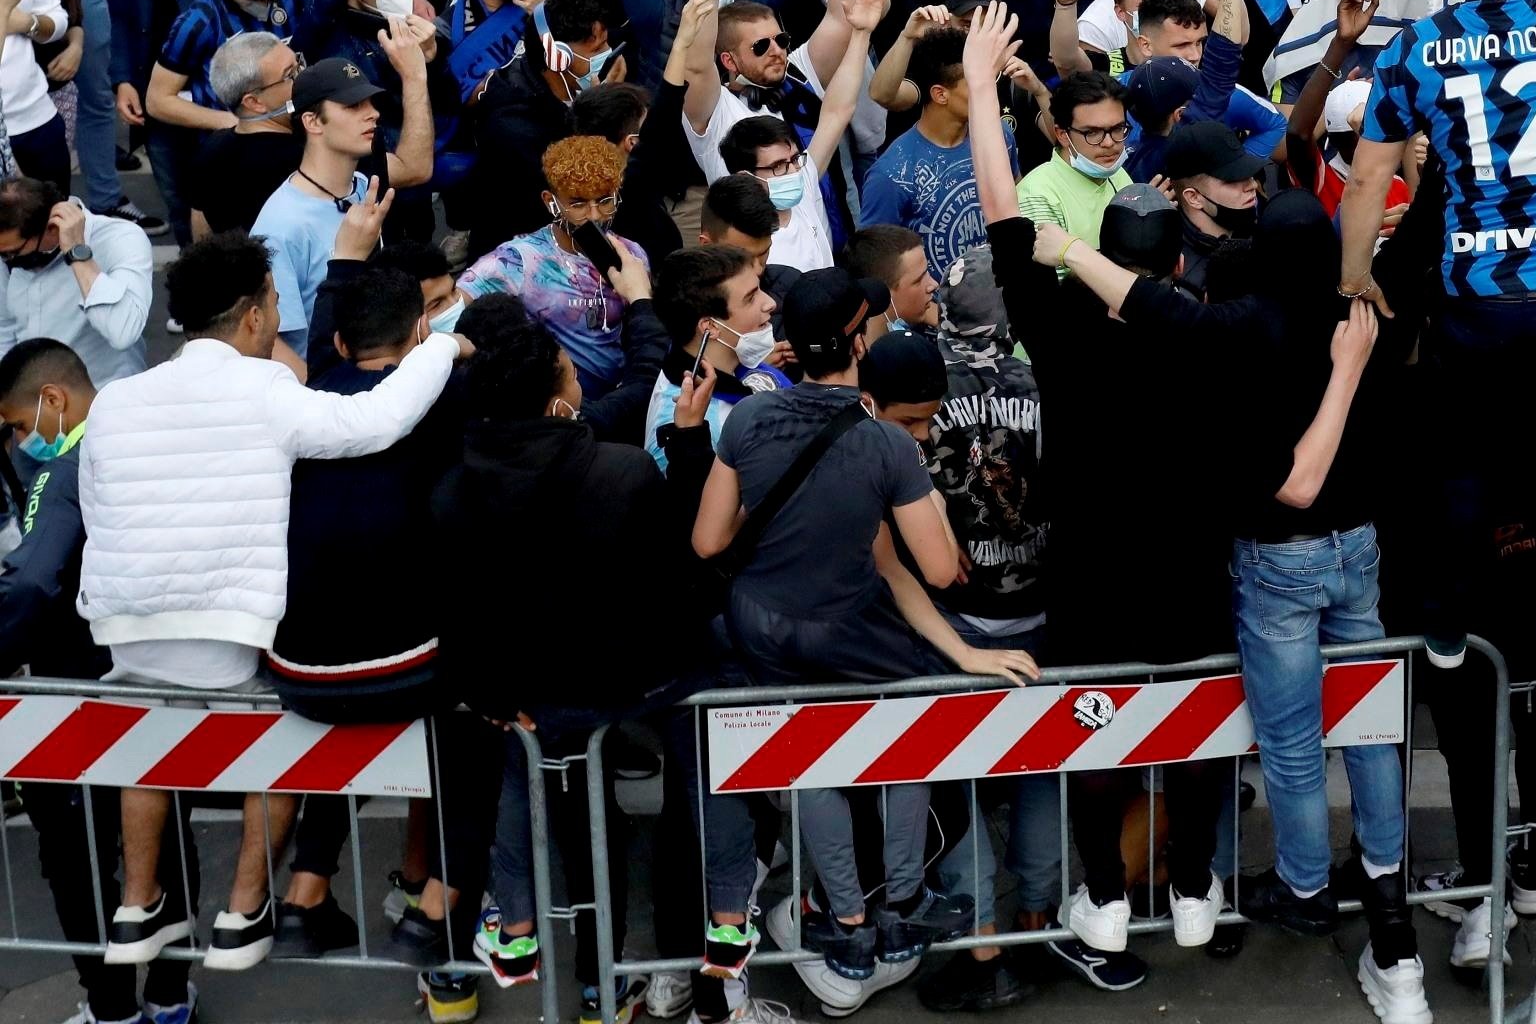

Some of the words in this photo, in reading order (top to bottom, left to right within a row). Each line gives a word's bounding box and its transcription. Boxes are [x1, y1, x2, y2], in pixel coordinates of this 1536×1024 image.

[1422, 32, 1500, 67] CURVA
[939, 203, 958, 234] NOT
[954, 186, 977, 206] THE
[568, 298, 607, 308] INFINITE
[745, 710, 753, 718] di
[756, 709, 781, 717] Milano
[724, 721, 747, 729] Polizia
[750, 720, 772, 728] Locale
